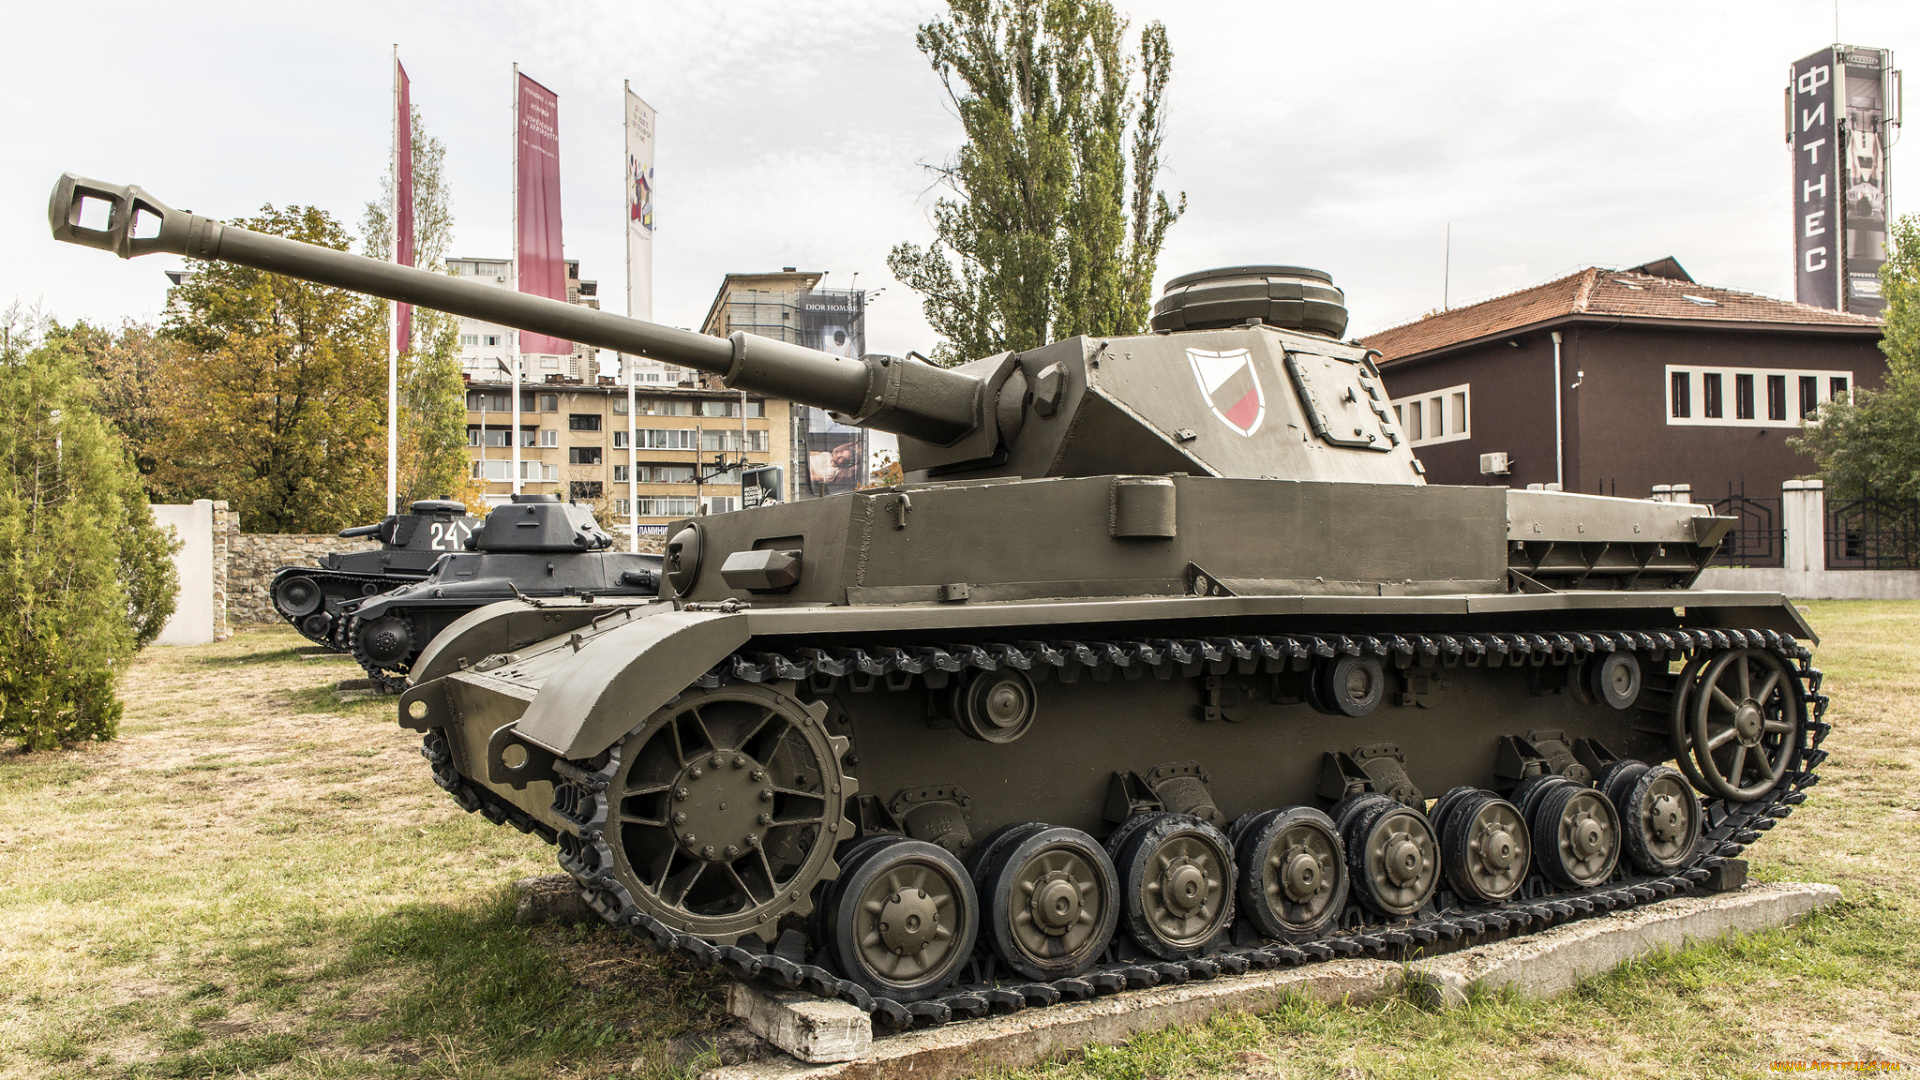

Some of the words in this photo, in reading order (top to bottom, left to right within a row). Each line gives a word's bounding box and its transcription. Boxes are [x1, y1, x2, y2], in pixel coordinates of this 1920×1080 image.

[1798, 65, 1829, 272] ФИТНЕС
[806, 303, 826, 311] DIOR
[828, 304, 859, 312] HOMME
[430, 521, 459, 550] 24
